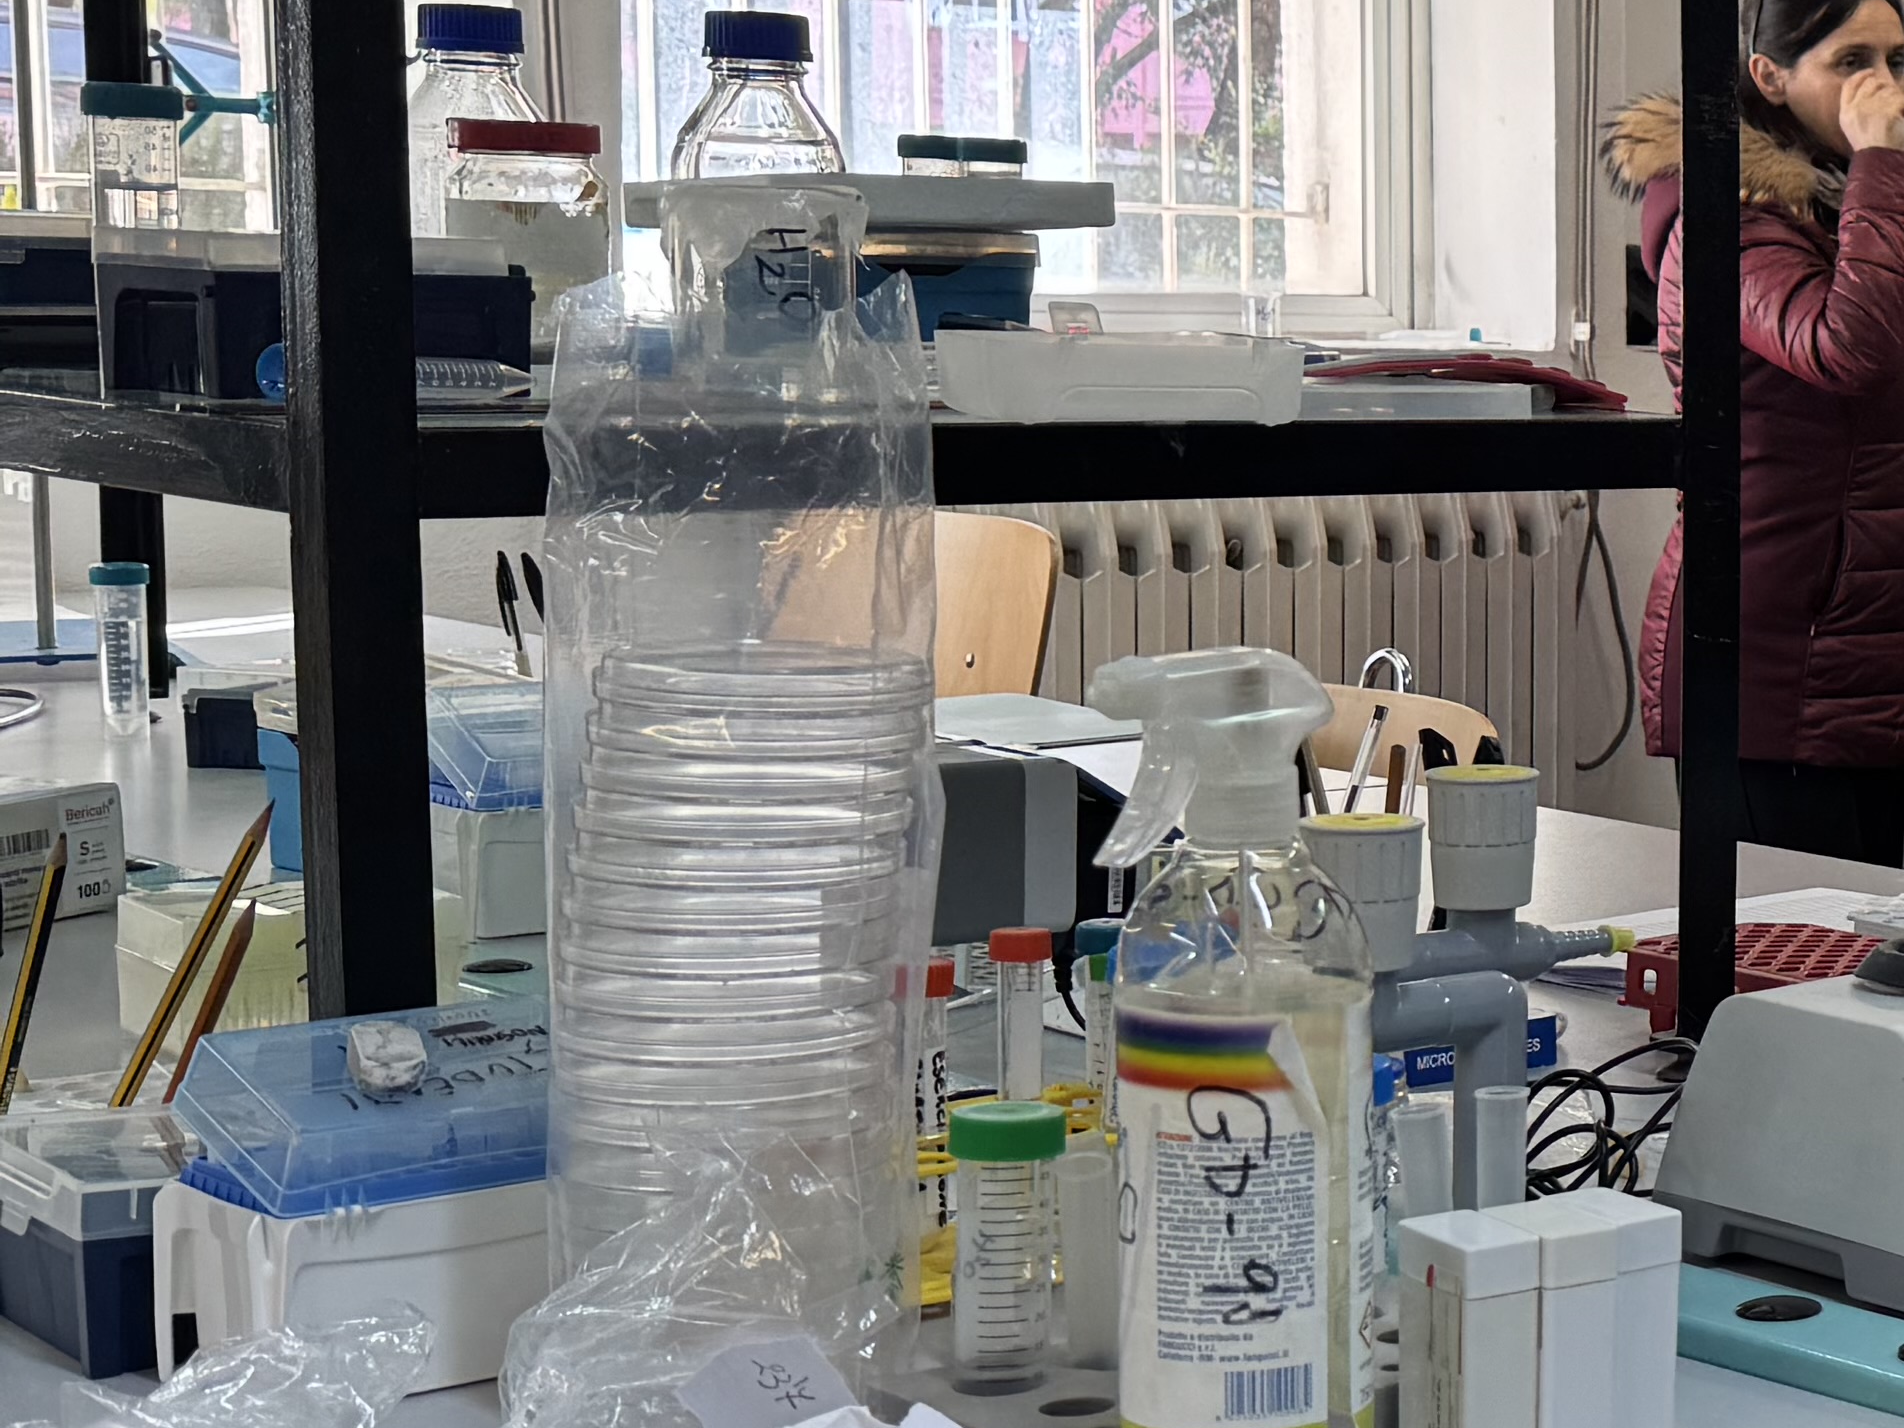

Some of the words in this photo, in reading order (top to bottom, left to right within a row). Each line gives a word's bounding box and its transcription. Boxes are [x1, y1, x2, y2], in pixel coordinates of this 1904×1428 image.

[79, 840, 90, 856] S
[77, 881, 101, 899] 100
[1416, 1051, 1456, 1071] MICRO
